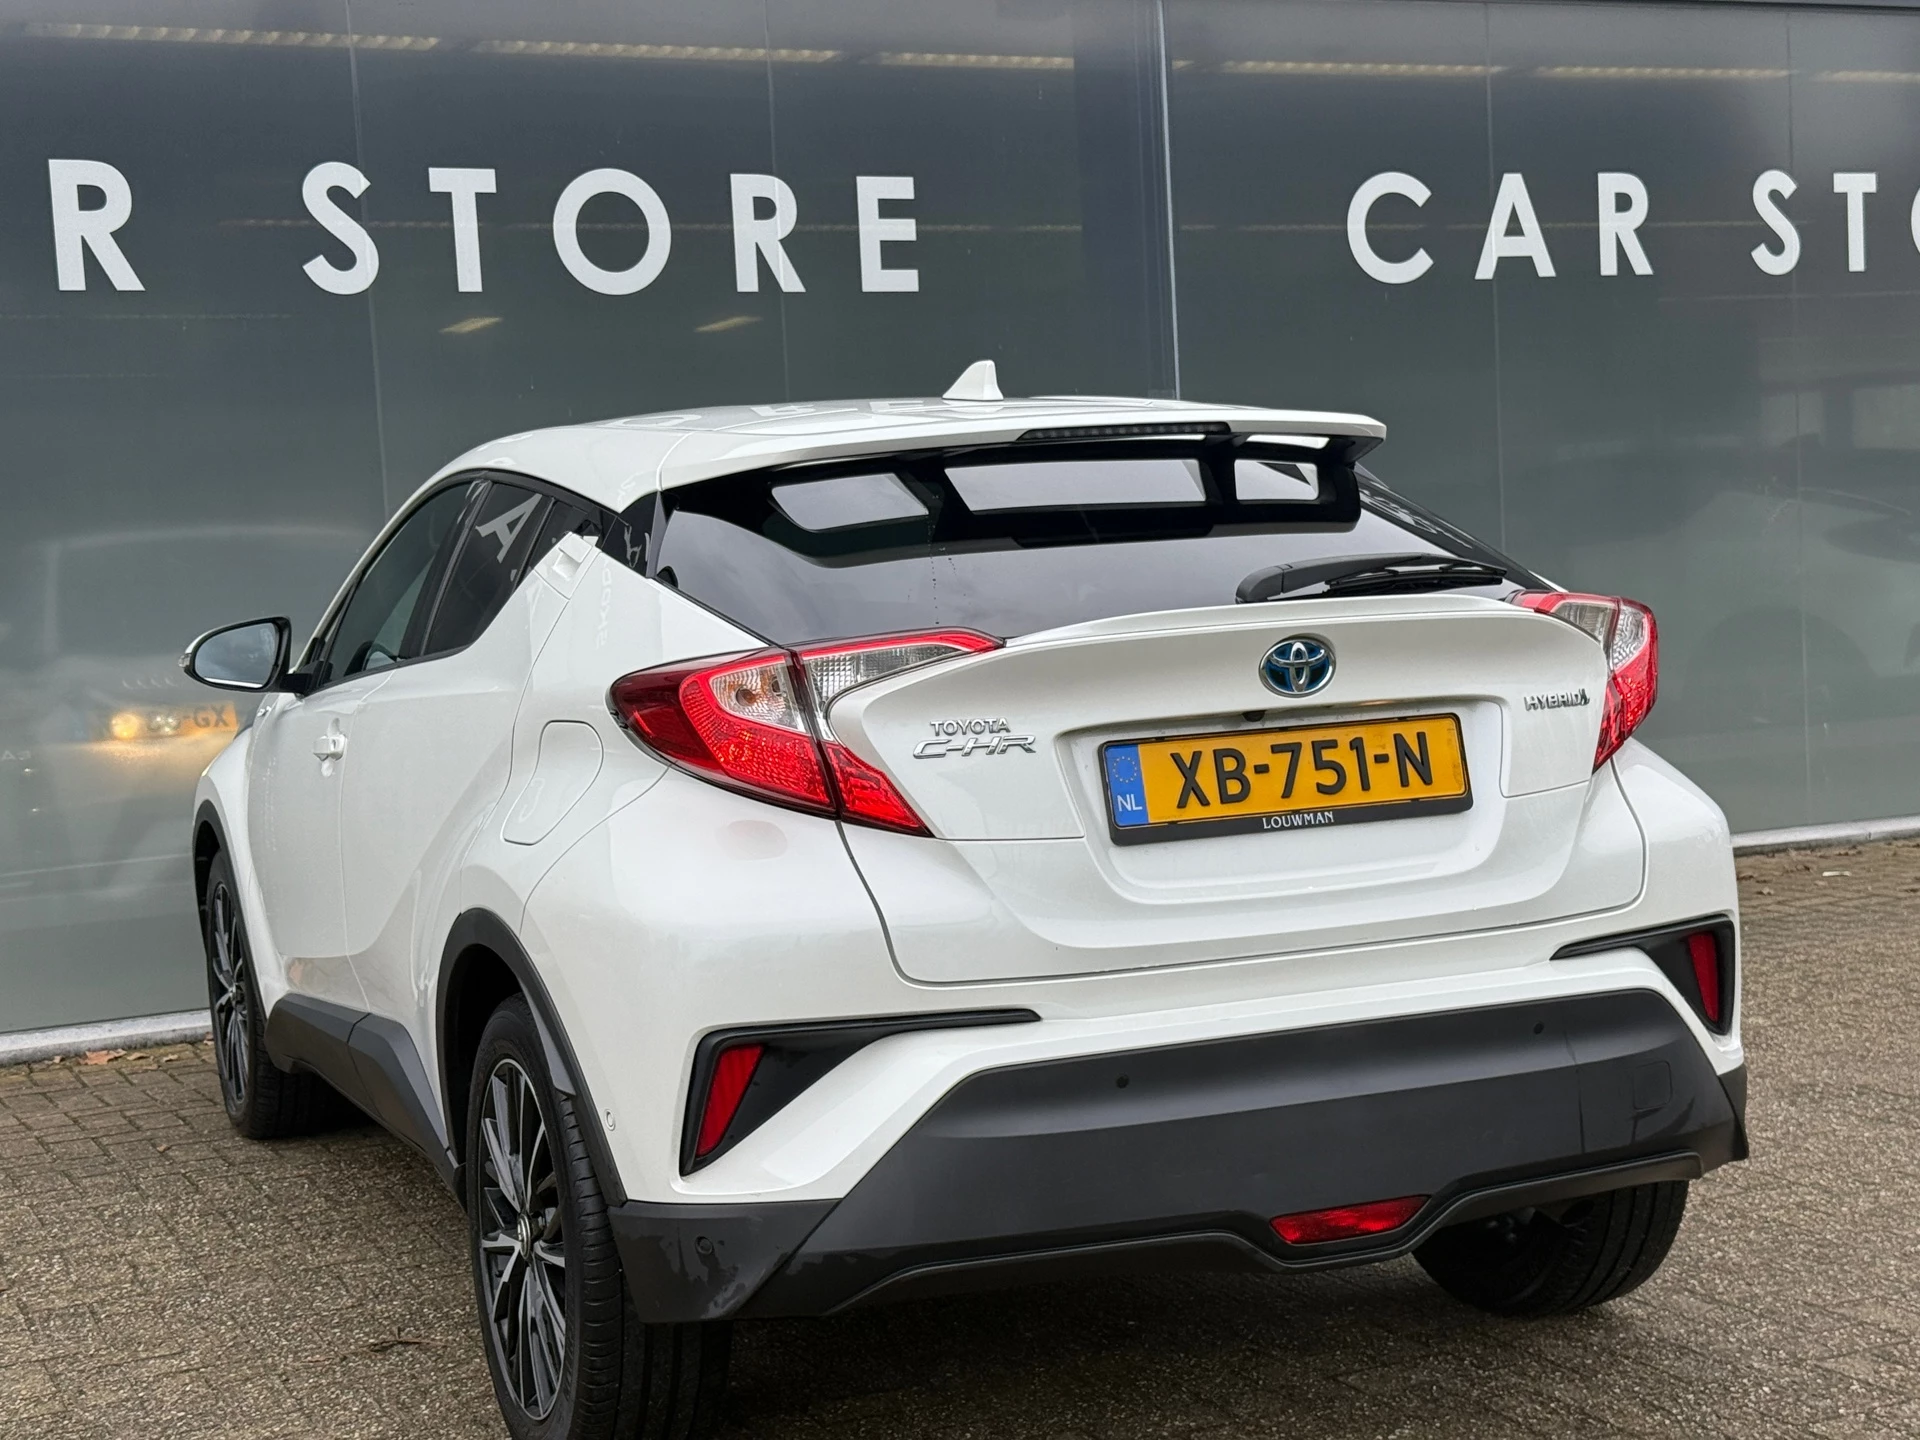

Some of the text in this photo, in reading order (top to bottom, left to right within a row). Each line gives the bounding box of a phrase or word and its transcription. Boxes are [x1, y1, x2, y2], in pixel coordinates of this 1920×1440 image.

[302, 161, 919, 296] STORE
[1347, 169, 1920, 284] CAR ST
[1523, 691, 1581, 712] HYBRID
[930, 717, 1011, 736] TOYOTA
[913, 735, 1036, 759] C-HR
[1117, 731, 1433, 812] NL XB-751-N
[1262, 811, 1335, 829] LOUWMAN
